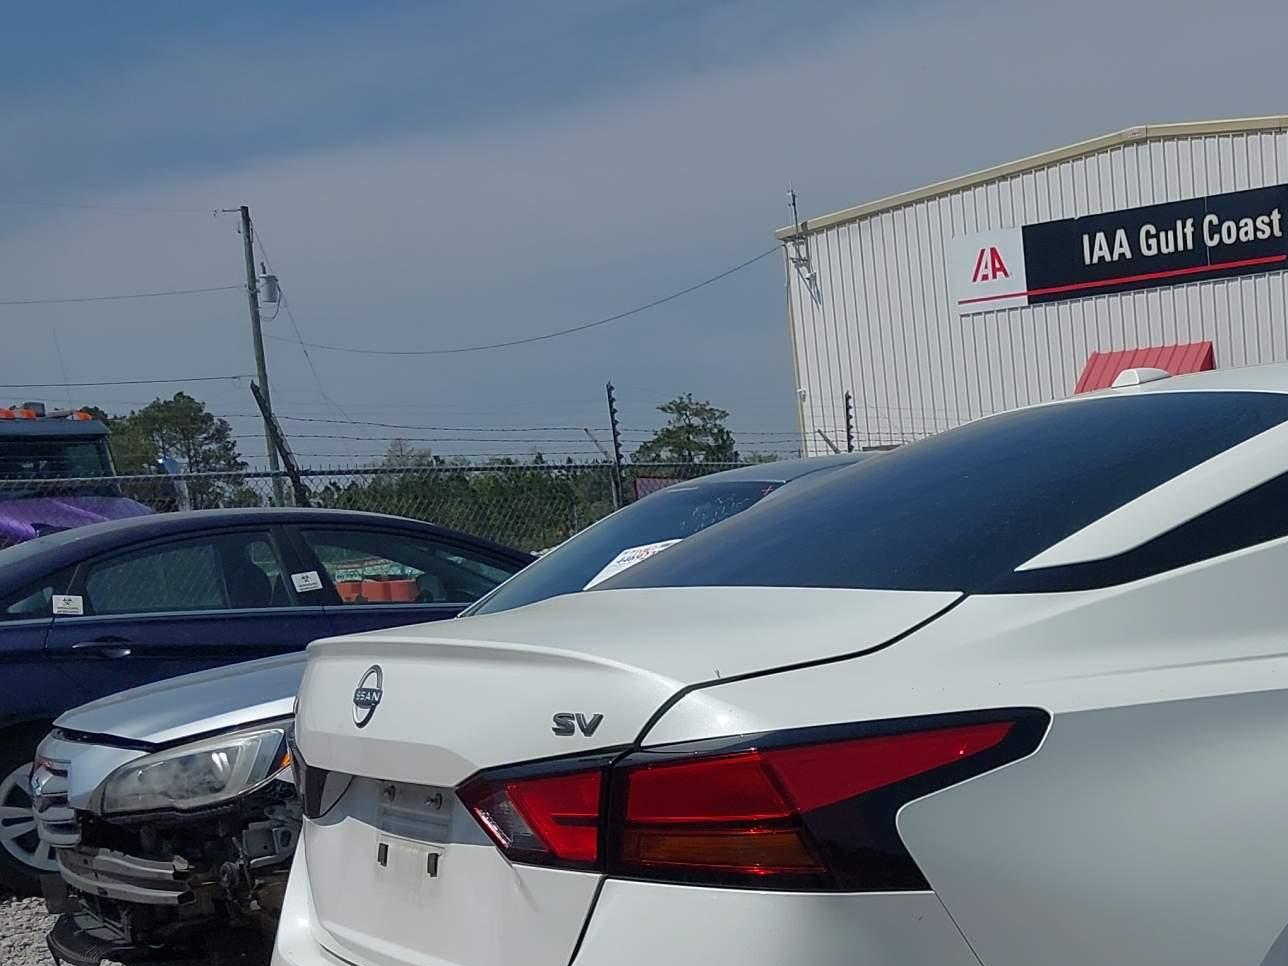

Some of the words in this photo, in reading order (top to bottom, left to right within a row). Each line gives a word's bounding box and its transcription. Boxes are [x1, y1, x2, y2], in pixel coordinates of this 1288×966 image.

[1082, 228, 1132, 265] IAA
[1139, 217, 1194, 257] Gulf
[1203, 207, 1283, 247] Coast
[552, 713, 604, 737] SV
